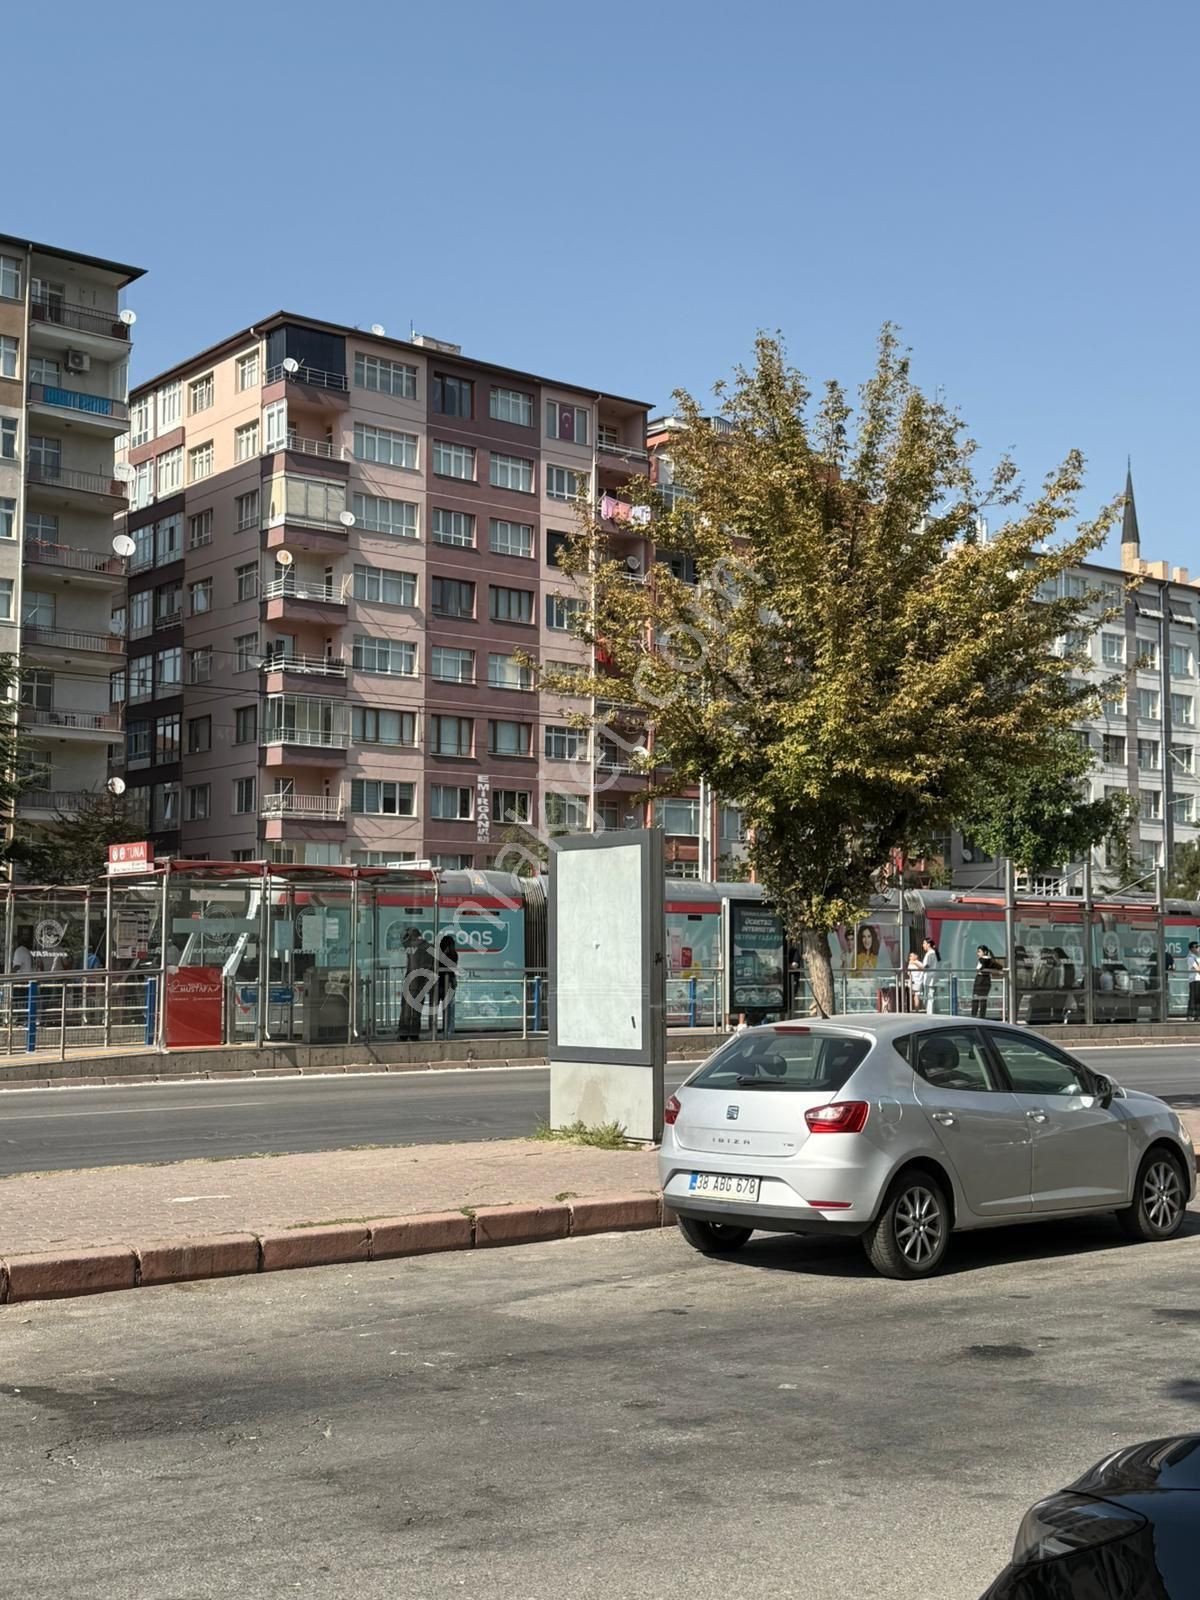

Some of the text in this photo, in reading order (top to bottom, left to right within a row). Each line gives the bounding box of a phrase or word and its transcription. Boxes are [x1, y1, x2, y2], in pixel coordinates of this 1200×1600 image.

[712, 1137, 751, 1145] IBIZA
[697, 1175, 709, 1189] 38
[736, 1178, 755, 1194] 678
